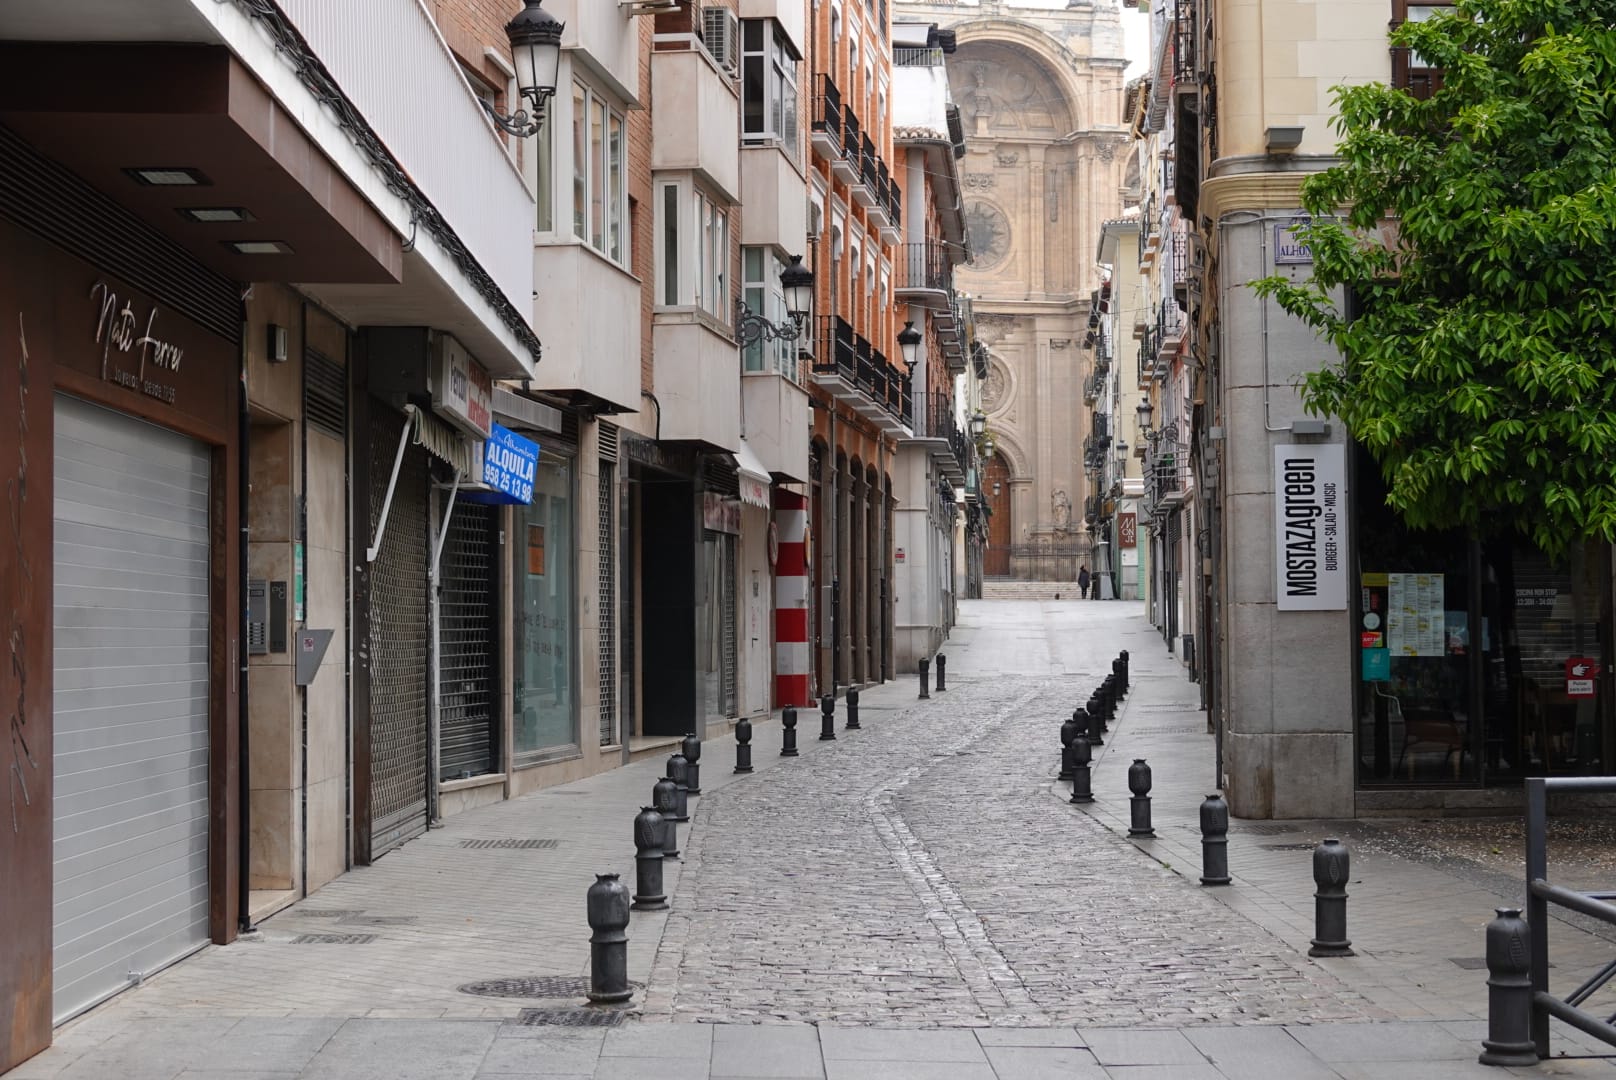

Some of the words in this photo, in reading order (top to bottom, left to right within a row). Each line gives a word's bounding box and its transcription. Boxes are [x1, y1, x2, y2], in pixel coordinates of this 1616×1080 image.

[1280, 245, 1313, 257] ALHON
[487, 442, 534, 483] ALQUILA
[485, 463, 499, 488] 958
[500, 472, 510, 491] 25
[511, 478, 521, 496] 13
[521, 482, 532, 501] 98
[1324, 483, 1337, 507] MUSIC
[1284, 458, 1323, 597] MOSTAZAgreen
[1324, 512, 1337, 536] SALAD
[1325, 542, 1338, 571] BURGER
